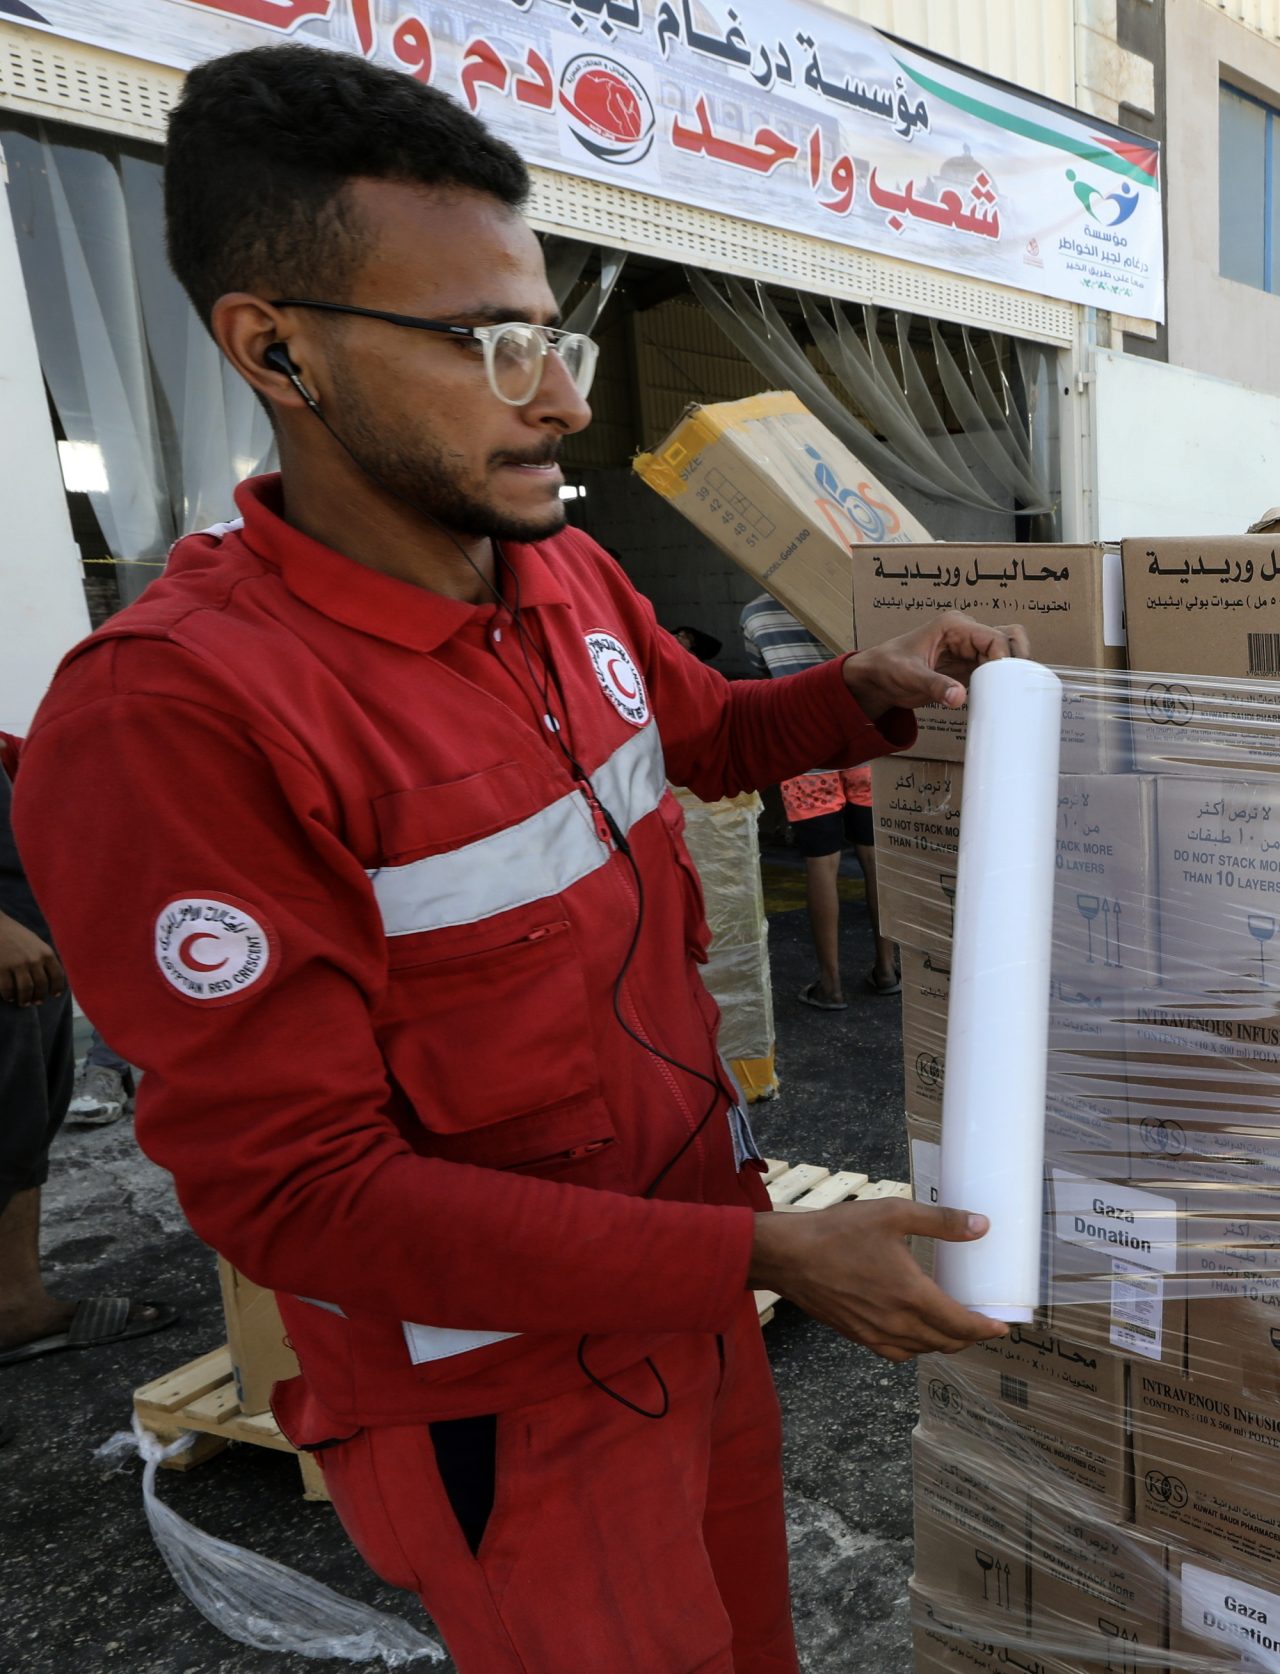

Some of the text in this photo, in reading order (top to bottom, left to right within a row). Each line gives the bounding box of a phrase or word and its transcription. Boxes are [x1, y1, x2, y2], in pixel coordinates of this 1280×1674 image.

[461, 38, 553, 113] دم
[799, 32, 932, 141] مؤسسة
[669, 96, 856, 216] واحد
[868, 169, 1002, 243] شعب
[1084, 225, 1127, 247] مؤسسة
[680, 456, 703, 480] SIZE
[710, 499, 722, 512] 42
[722, 511, 734, 524] 45
[734, 523, 747, 536] 48
[746, 533, 759, 547] 51
[873, 556, 1070, 588] محاليل وريدية
[1146, 551, 1254, 584] وريدية
[880, 817, 960, 838] DO NOT STACK MO
[888, 836, 958, 854] THAN 10 LAYER
[1174, 849, 1189, 862] DO
[1192, 851, 1215, 866] NOT
[1218, 854, 1256, 870] STACK
[1183, 871, 1212, 884] THAN
[1216, 871, 1234, 887] 10
[208, 979, 233, 994] RED
[232, 936, 261, 984] CRESCENT
[1137, 1007, 1233, 1036] INTRAVENOUS
[1092, 1198, 1135, 1224] Gaza
[1074, 1216, 1151, 1254] Donation
[1201, 1258, 1215, 1271] DO
[1218, 1265, 1239, 1278] NOT
[1244, 1271, 1279, 1288] STACK
[1211, 1281, 1238, 1293] THAN
[1241, 1285, 1258, 1300] 10
[1142, 1377, 1230, 1417] INTRAVENOUS
[1193, 1503, 1218, 1518] KUWAIT
[1219, 1511, 1240, 1527] SAUDI
[1224, 1595, 1268, 1625] Gaza
